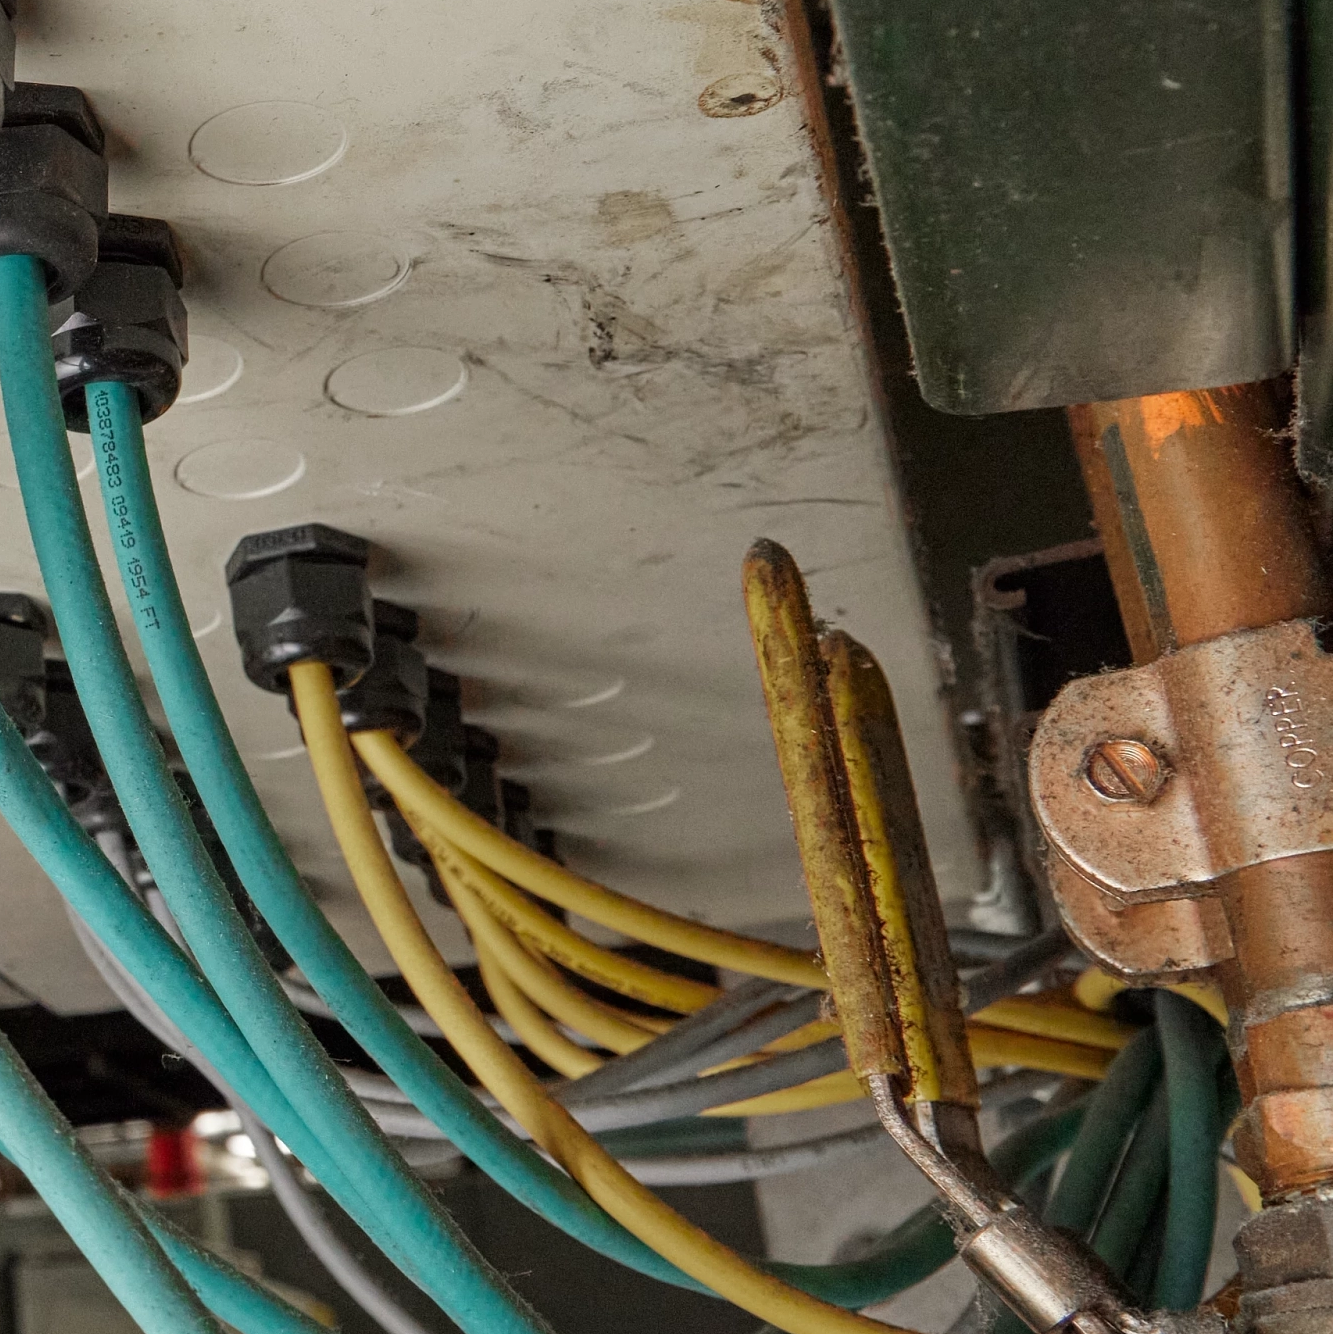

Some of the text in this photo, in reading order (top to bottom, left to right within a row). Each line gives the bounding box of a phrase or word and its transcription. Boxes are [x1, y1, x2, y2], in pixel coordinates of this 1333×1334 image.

[95, 390, 160, 630] 103878483 09419 1954 FT
[1266, 686, 1325, 788] COPPER
